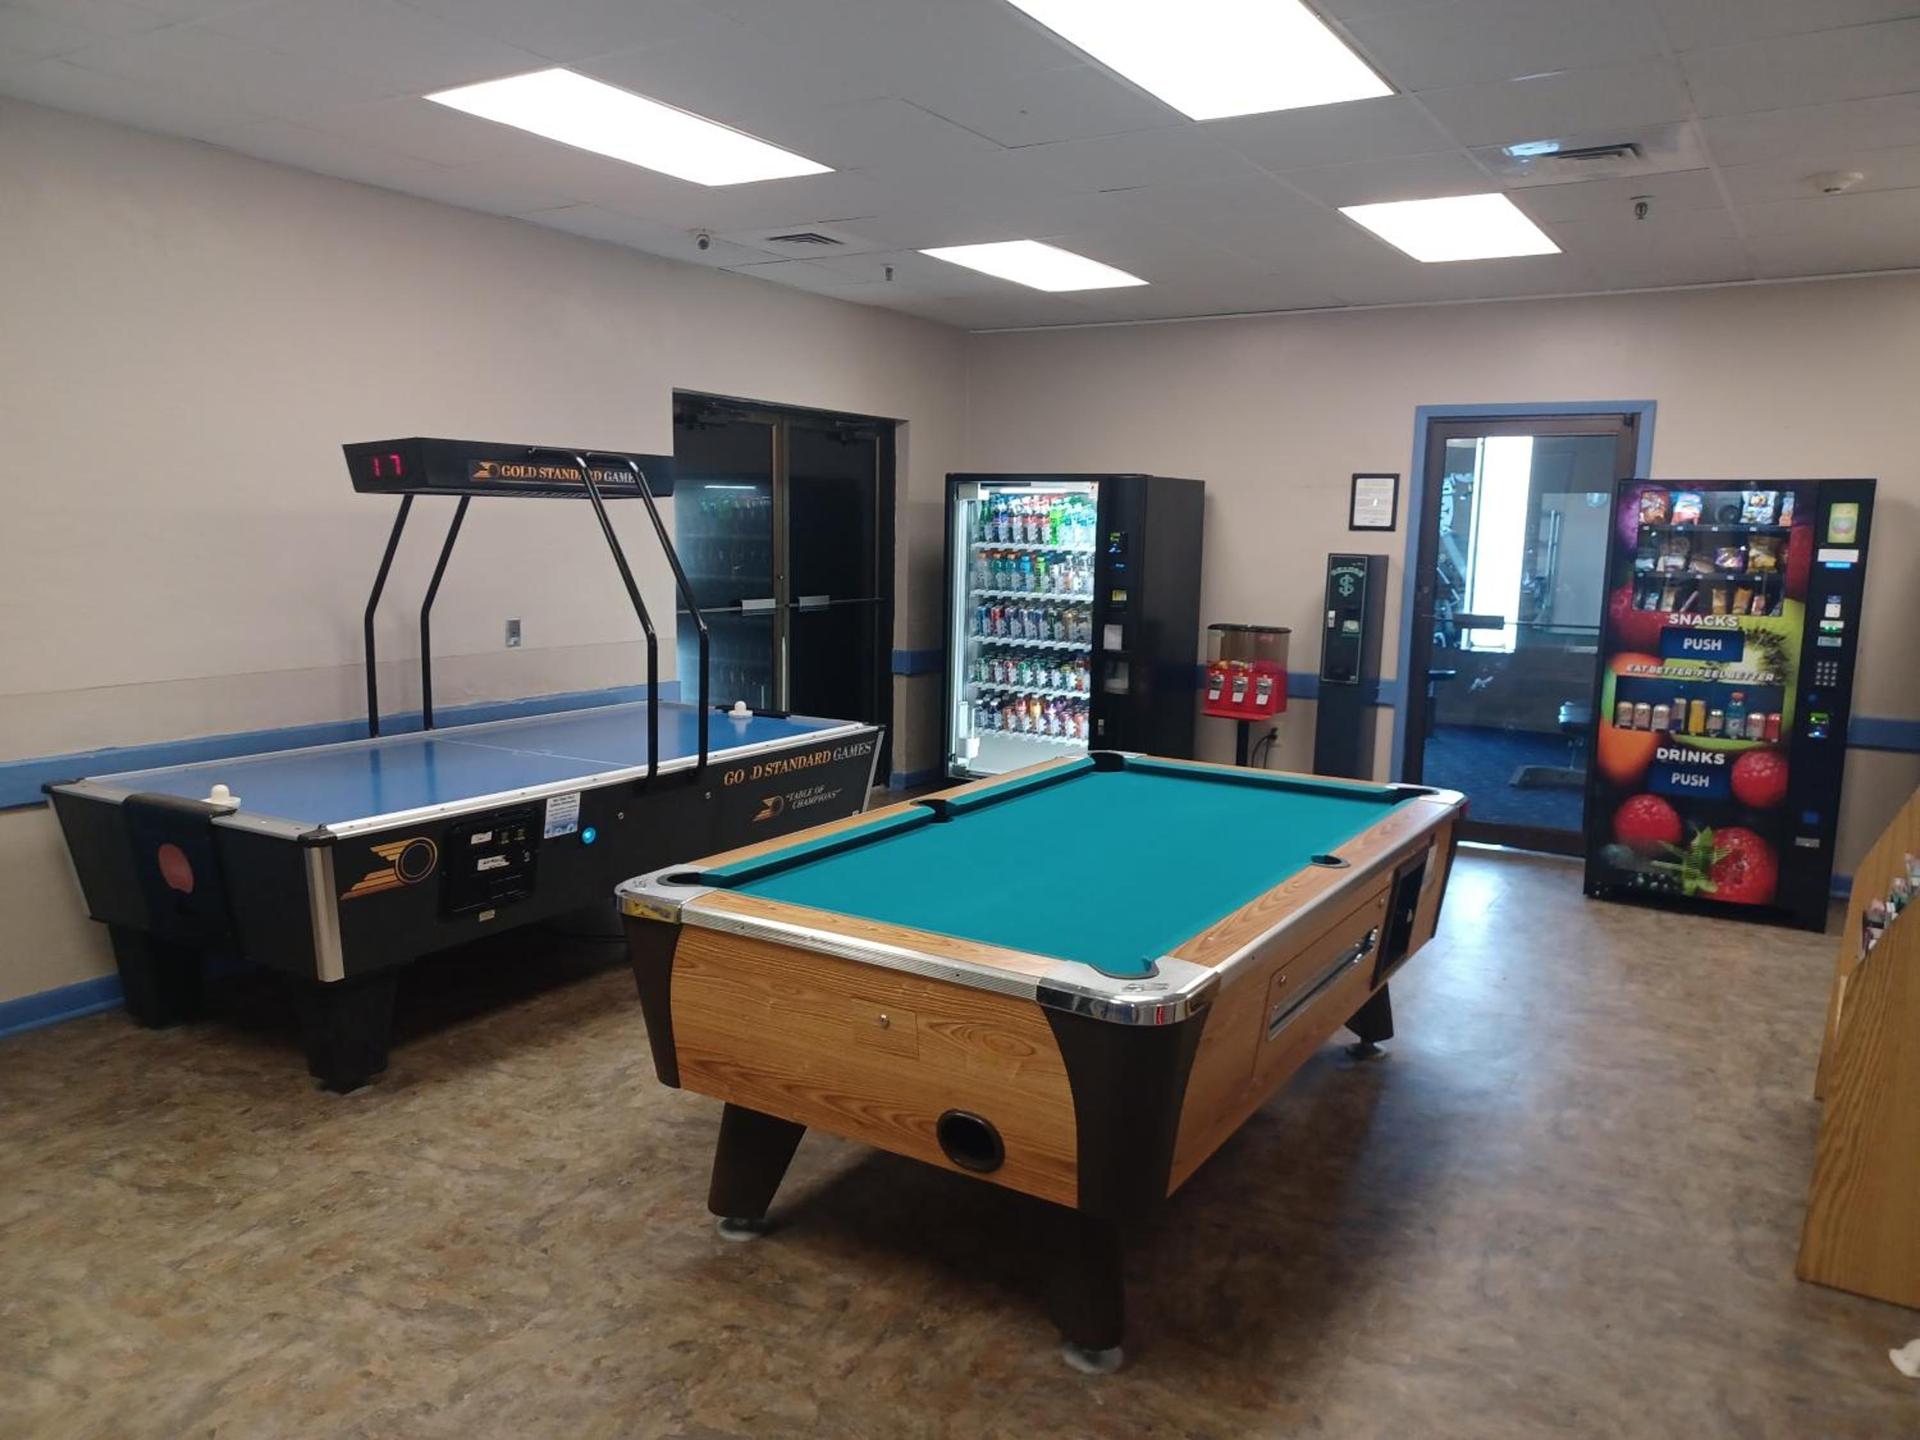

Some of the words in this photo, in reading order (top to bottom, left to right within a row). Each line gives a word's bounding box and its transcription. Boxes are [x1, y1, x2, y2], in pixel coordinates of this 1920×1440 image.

[371, 453, 401, 477] 17
[501, 465, 537, 478] GOLD
[539, 467, 603, 481] STANDD
[603, 471, 638, 484] GAME
[1669, 613, 1738, 627] SNACKS
[1683, 637, 1723, 651] PUSH
[724, 766, 763, 787] GOD
[764, 750, 832, 777] STANDARD
[832, 742, 872, 762] GAMES
[1656, 747, 1726, 765] DRINKS
[1671, 772, 1710, 788] PUSH
